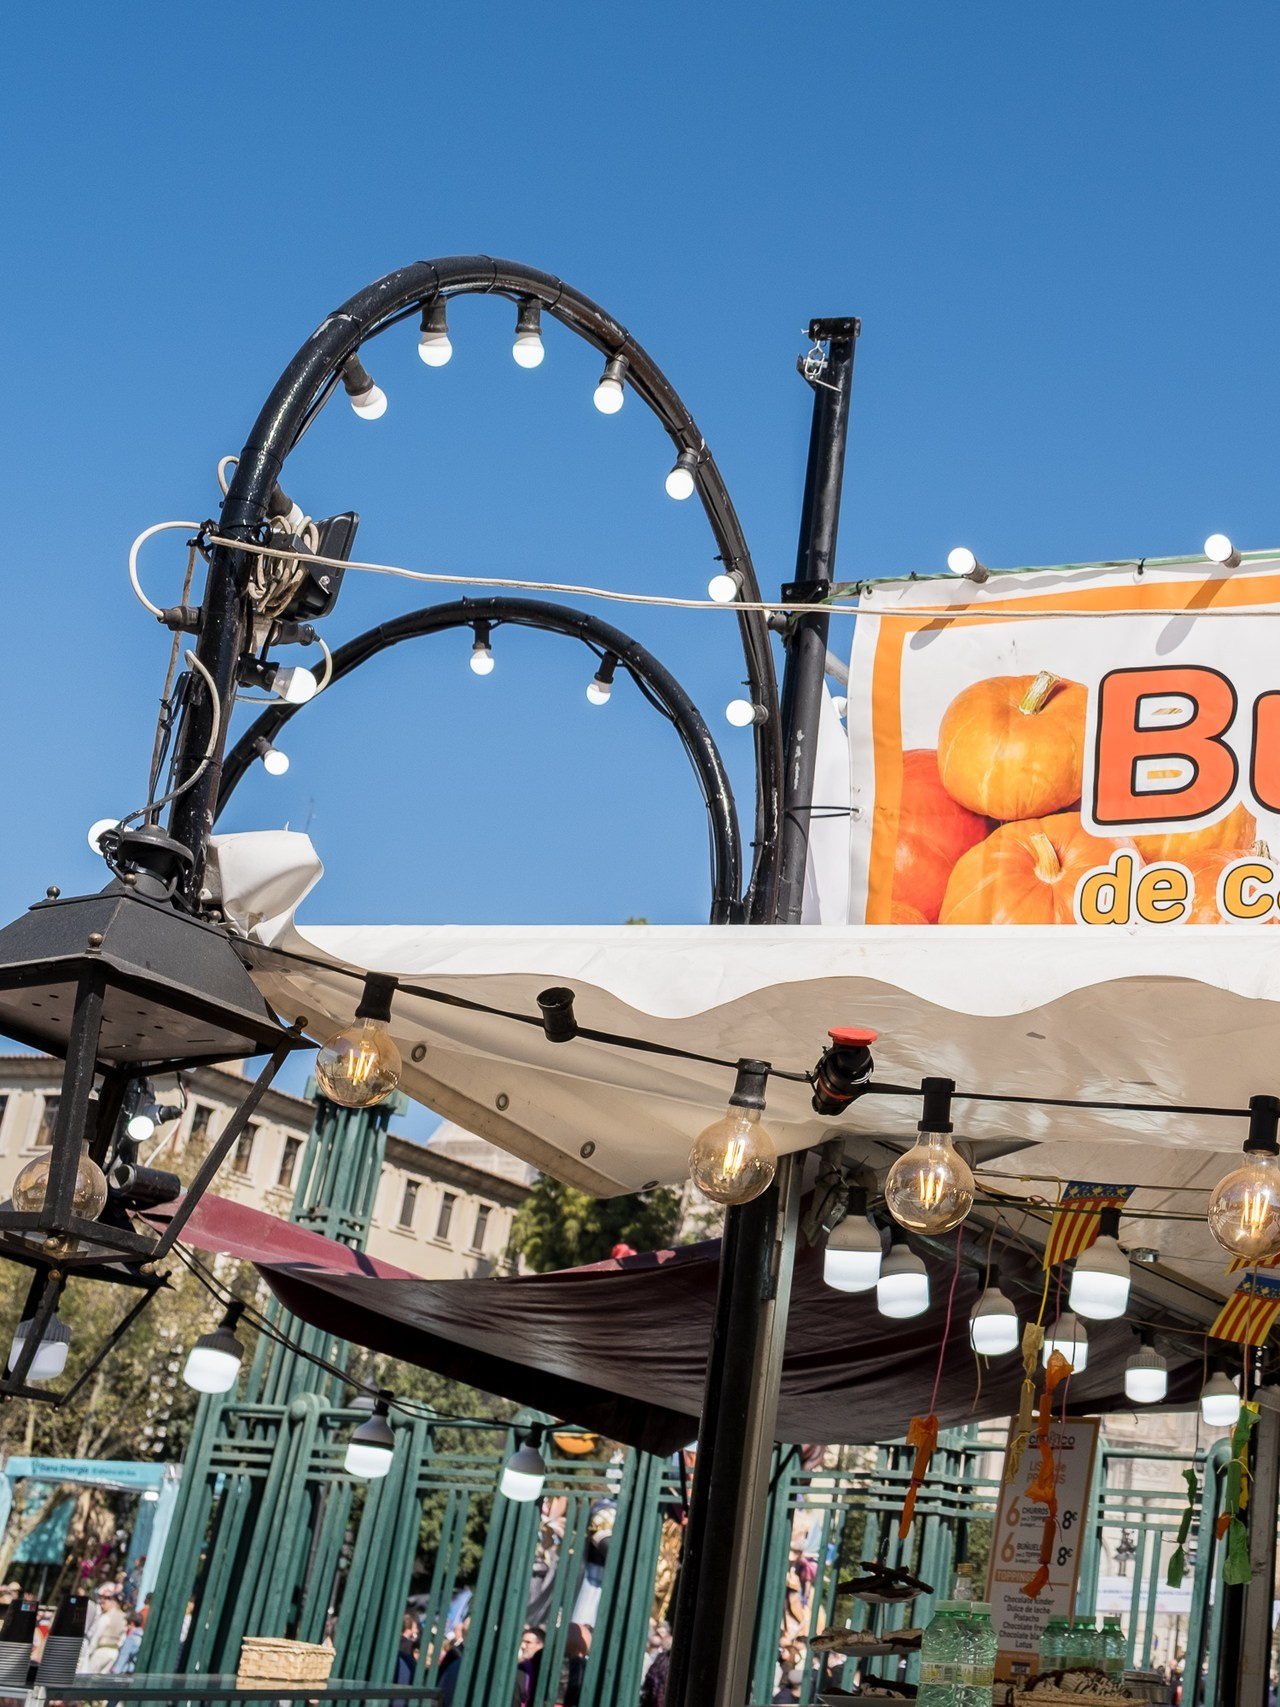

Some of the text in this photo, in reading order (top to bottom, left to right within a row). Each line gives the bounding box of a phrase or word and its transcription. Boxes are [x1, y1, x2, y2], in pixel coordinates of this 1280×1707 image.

[1080, 854, 1188, 925] de
[1006, 1496, 1020, 1527] 6
[1001, 1532, 1015, 1563] 6
[1003, 1594, 1033, 1604] Chocolate
[1007, 1604, 1051, 1614] Dulce de leche
[1014, 1613, 1039, 1622] Pistacho
[1003, 1622, 1032, 1631] Chocolate
[999, 1631, 1029, 1639] Chocolate
[1015, 1641, 1032, 1649] Lotus
